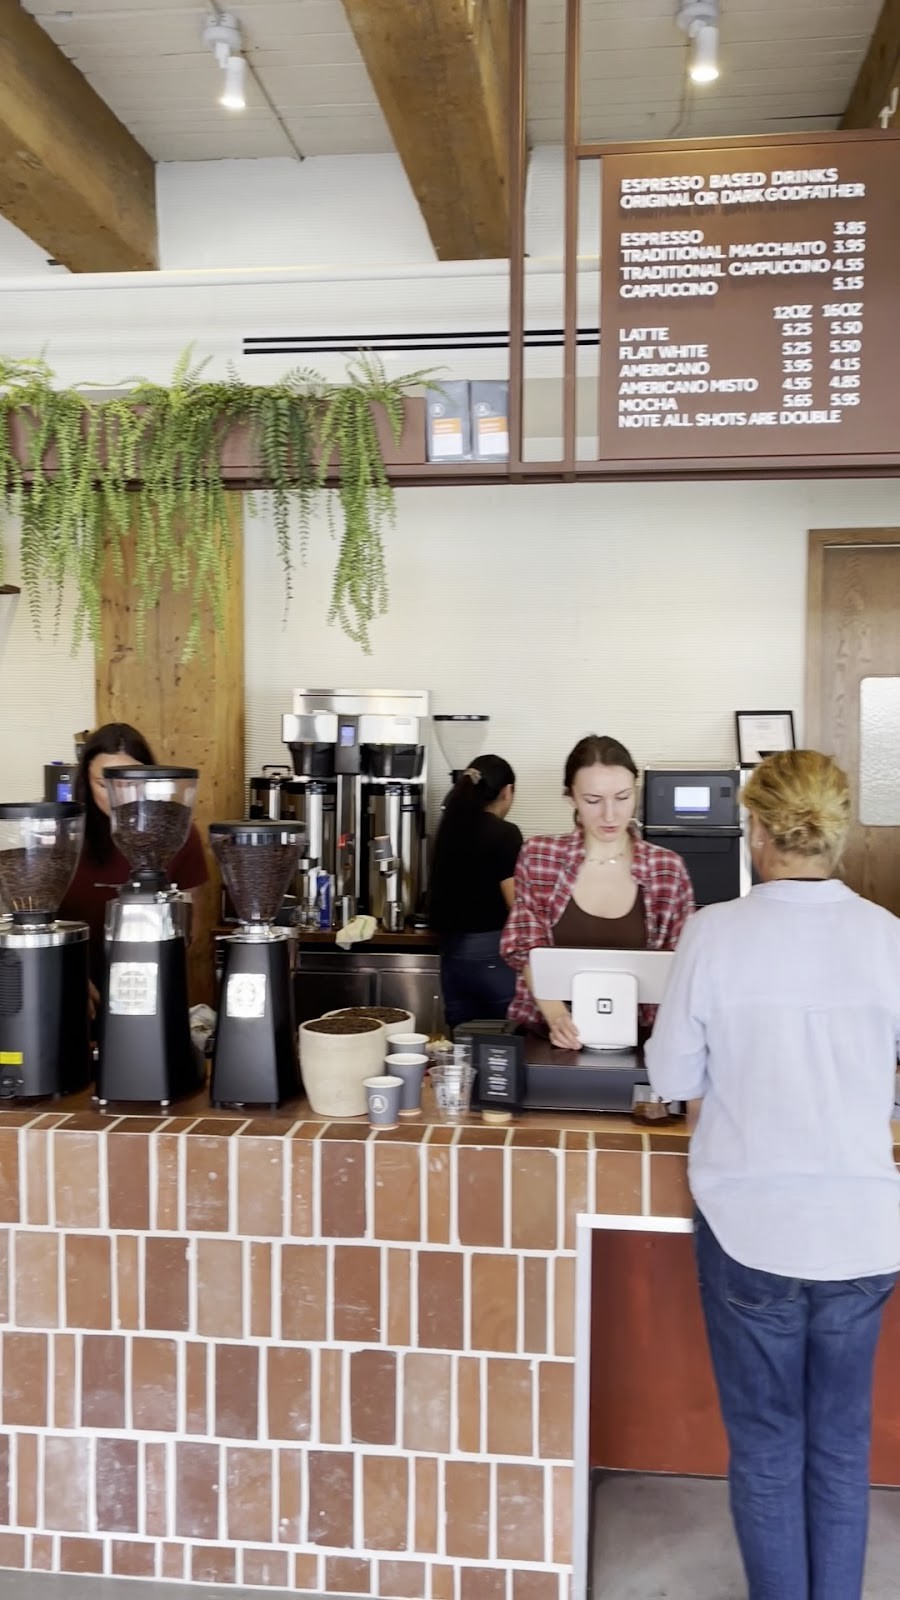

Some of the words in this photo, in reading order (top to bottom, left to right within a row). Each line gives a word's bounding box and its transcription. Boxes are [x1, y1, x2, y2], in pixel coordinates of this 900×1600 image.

[621, 175, 705, 193] ESPRESSO
[709, 172, 767, 189] BASED
[771, 167, 839, 186] DRINKS
[620, 192, 695, 209] ORIGINAL
[694, 191, 719, 206] OR
[720, 188, 765, 205] DARK
[764, 183, 866, 202] GODFATHER
[620, 229, 704, 246] ESPRESSO
[832, 221, 866, 235] 3.85
[620, 245, 727, 263] TRADITIONAL
[728, 240, 827, 258] MACCHIATO
[832, 239, 866, 254] 3.95
[620, 262, 727, 280] TRADITIONAL
[728, 258, 831, 276] CAPPUCCINO
[832, 257, 865, 272] 4.55
[619, 281, 719, 298] CAPPUCCINO
[832, 276, 865, 291] 5.15
[619, 327, 670, 342] LATTE
[781, 322, 813, 336] 5.25
[829, 320, 863, 335] 5.50
[619, 345, 657, 360] FLAT
[657, 344, 709, 359] WHITE
[781, 341, 813, 356] 5.25
[829, 339, 862, 353] 5.50
[619, 361, 711, 377] AMERICANO
[782, 358, 814, 373] 3.95
[829, 357, 861, 371] 4.15
[618, 379, 709, 395] AMERICANO
[709, 378, 759, 393] MISTO
[781, 376, 813, 390] 4.55
[828, 374, 861, 388] 4.85
[618, 397, 679, 412] MOCHA
[829, 392, 861, 406] 5.95
[618, 414, 662, 428] NOTE
[662, 413, 694, 427] ALL
[695, 412, 748, 427] SHOTS
[747, 411, 779, 426] ARE
[779, 409, 842, 425] DOUBLE
